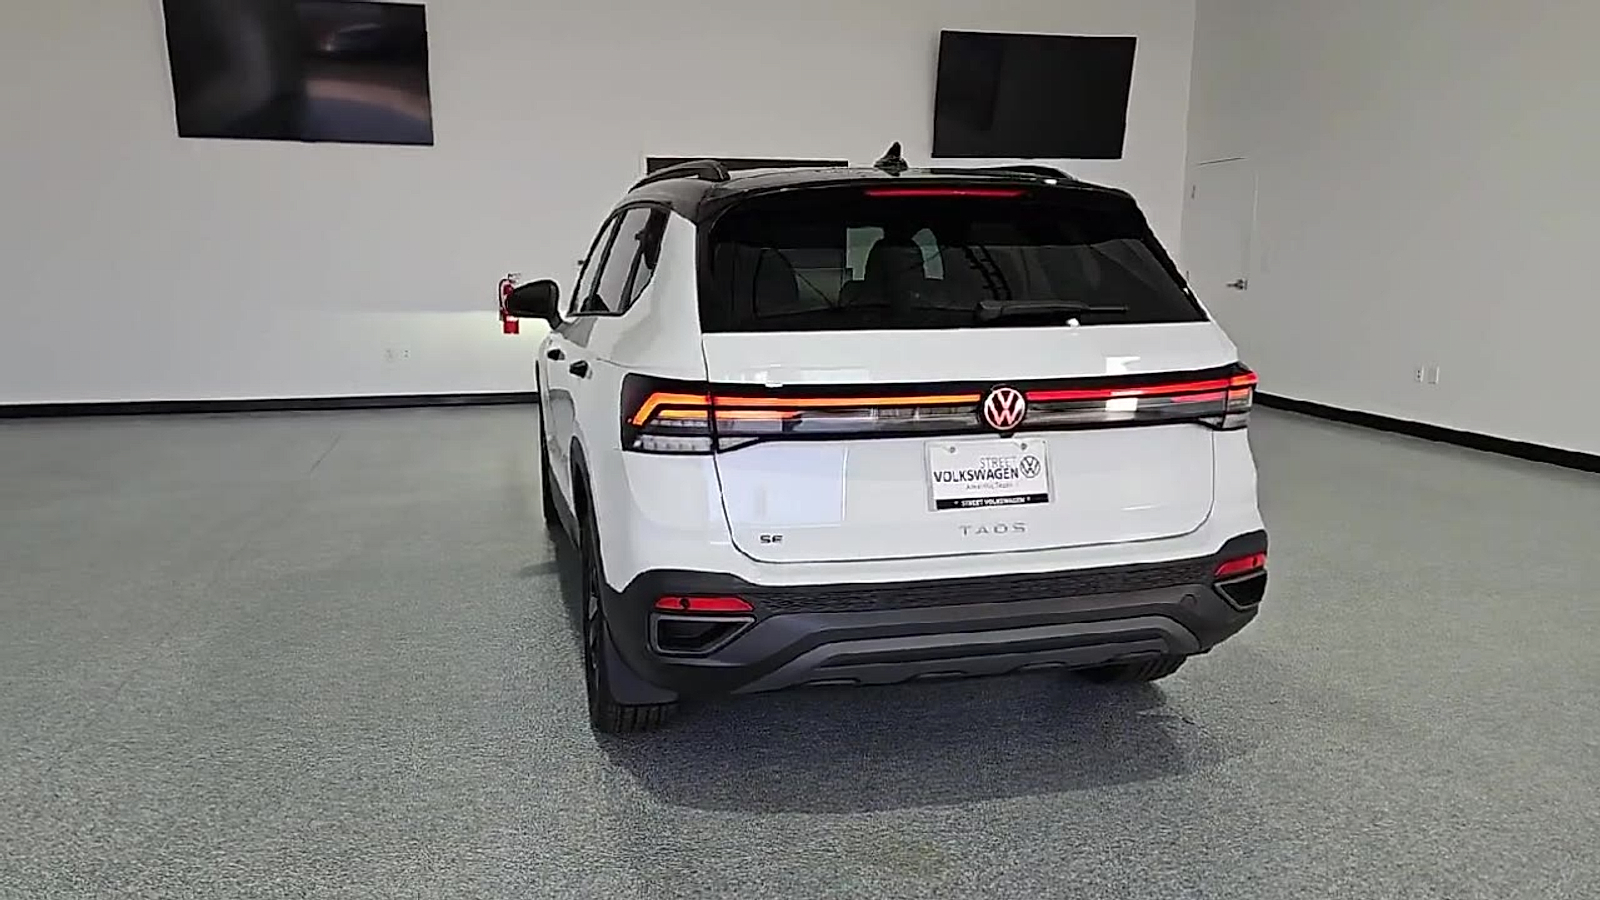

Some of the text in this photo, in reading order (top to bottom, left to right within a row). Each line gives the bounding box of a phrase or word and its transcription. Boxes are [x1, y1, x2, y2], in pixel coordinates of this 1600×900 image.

[980, 456, 1017, 469] STREET
[933, 467, 1019, 482] VOLKSWAGEN
[958, 522, 1026, 536] TAOS
